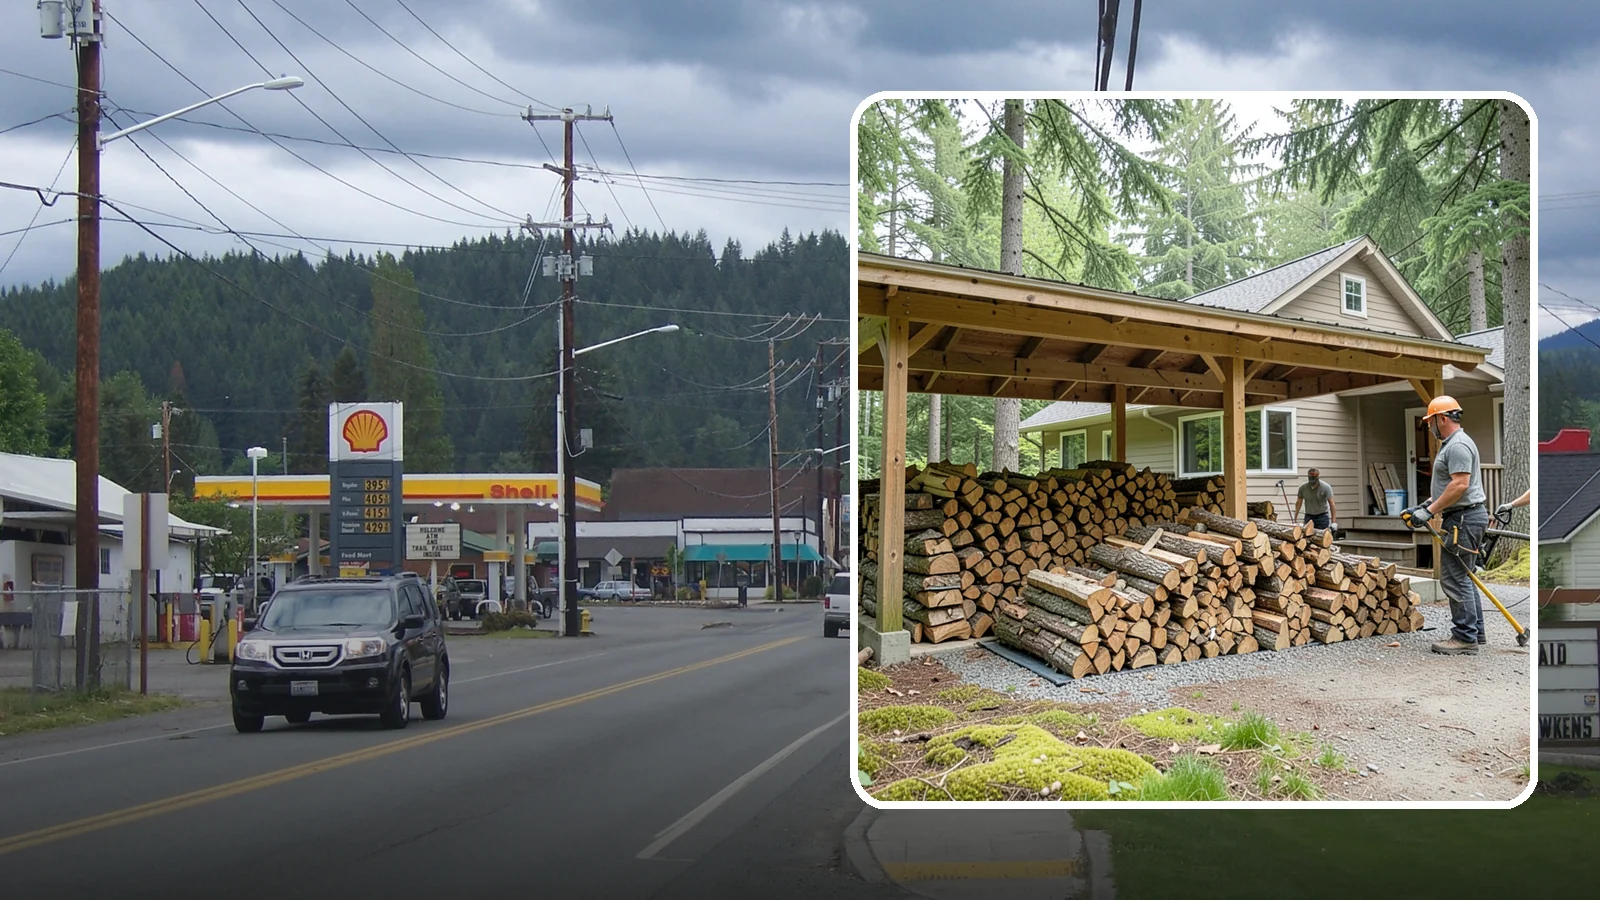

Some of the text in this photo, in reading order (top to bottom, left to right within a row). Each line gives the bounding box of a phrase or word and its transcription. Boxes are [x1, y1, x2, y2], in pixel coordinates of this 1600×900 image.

[366, 480, 383, 490] 395
[490, 484, 547, 499] Shell
[366, 494, 383, 504] 405
[366, 508, 383, 518] 415
[366, 522, 383, 532] 429
[1538, 643, 1566, 665] AID
